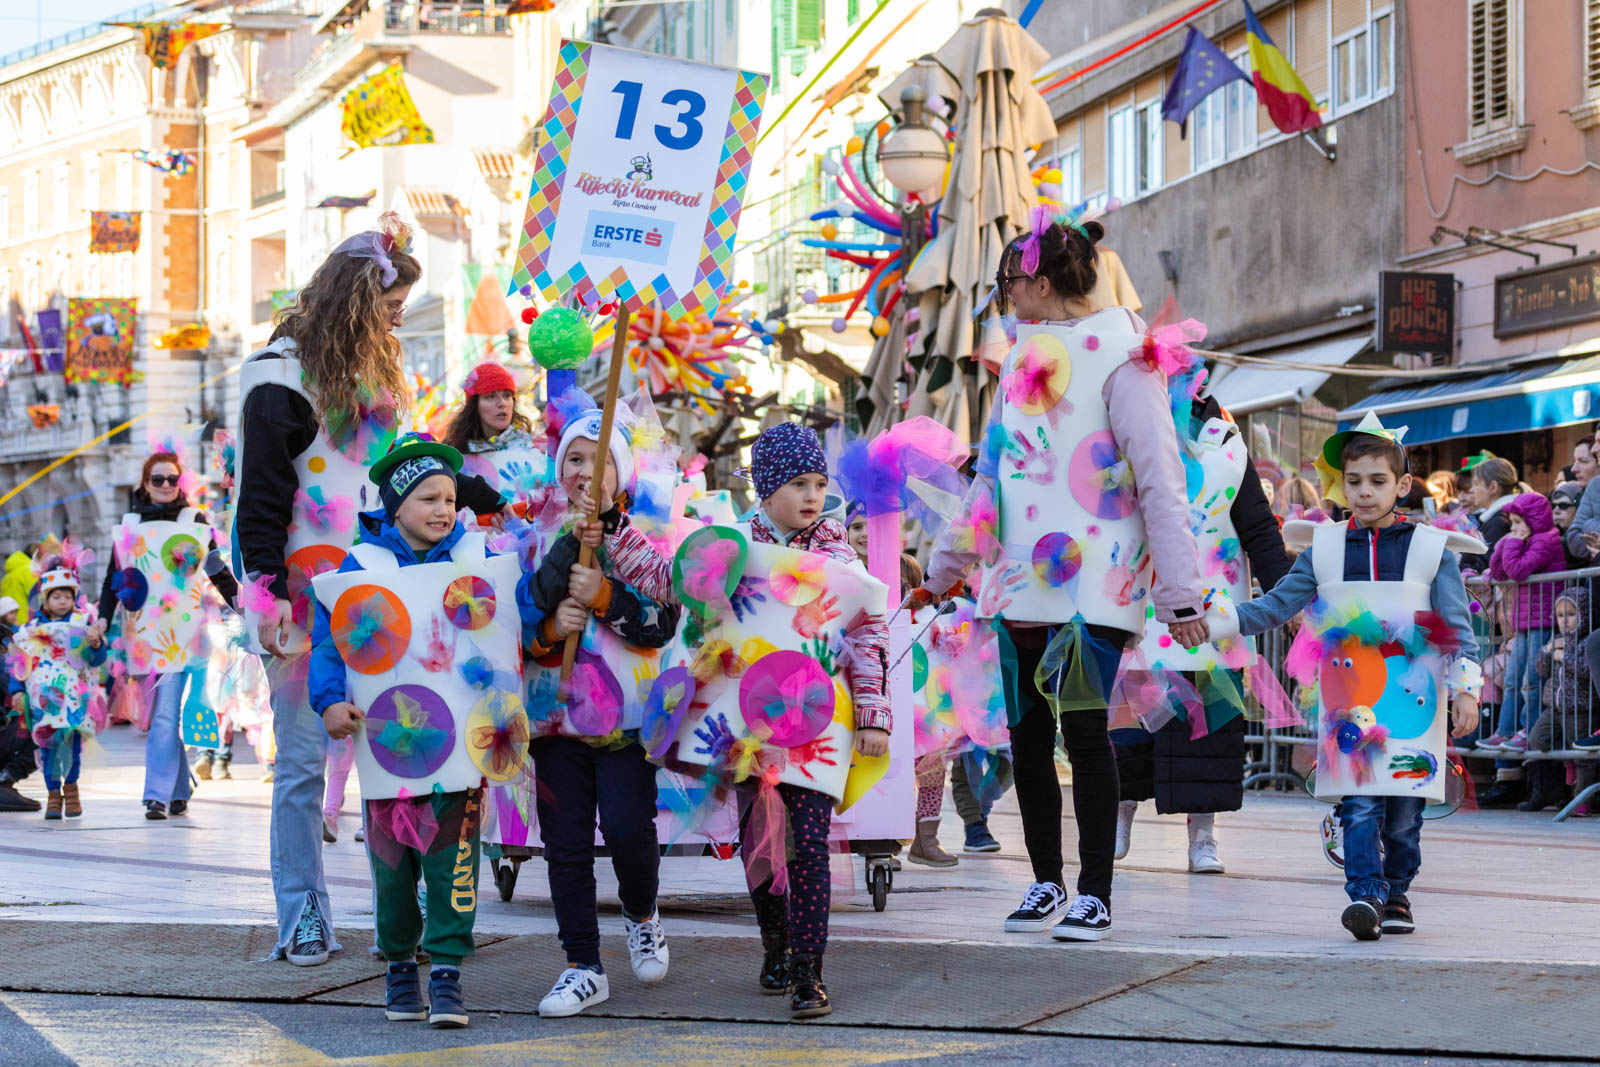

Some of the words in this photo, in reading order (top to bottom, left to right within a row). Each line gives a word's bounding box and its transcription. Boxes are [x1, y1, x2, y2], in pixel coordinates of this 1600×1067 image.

[611, 80, 707, 151] 13
[574, 172, 631, 200] Riječki
[630, 177, 704, 208] Karneval
[592, 240, 612, 249] Bank
[593, 225, 644, 244] ERSTE
[1401, 279, 1437, 304] HUG
[1388, 305, 1448, 334] PUNCH
